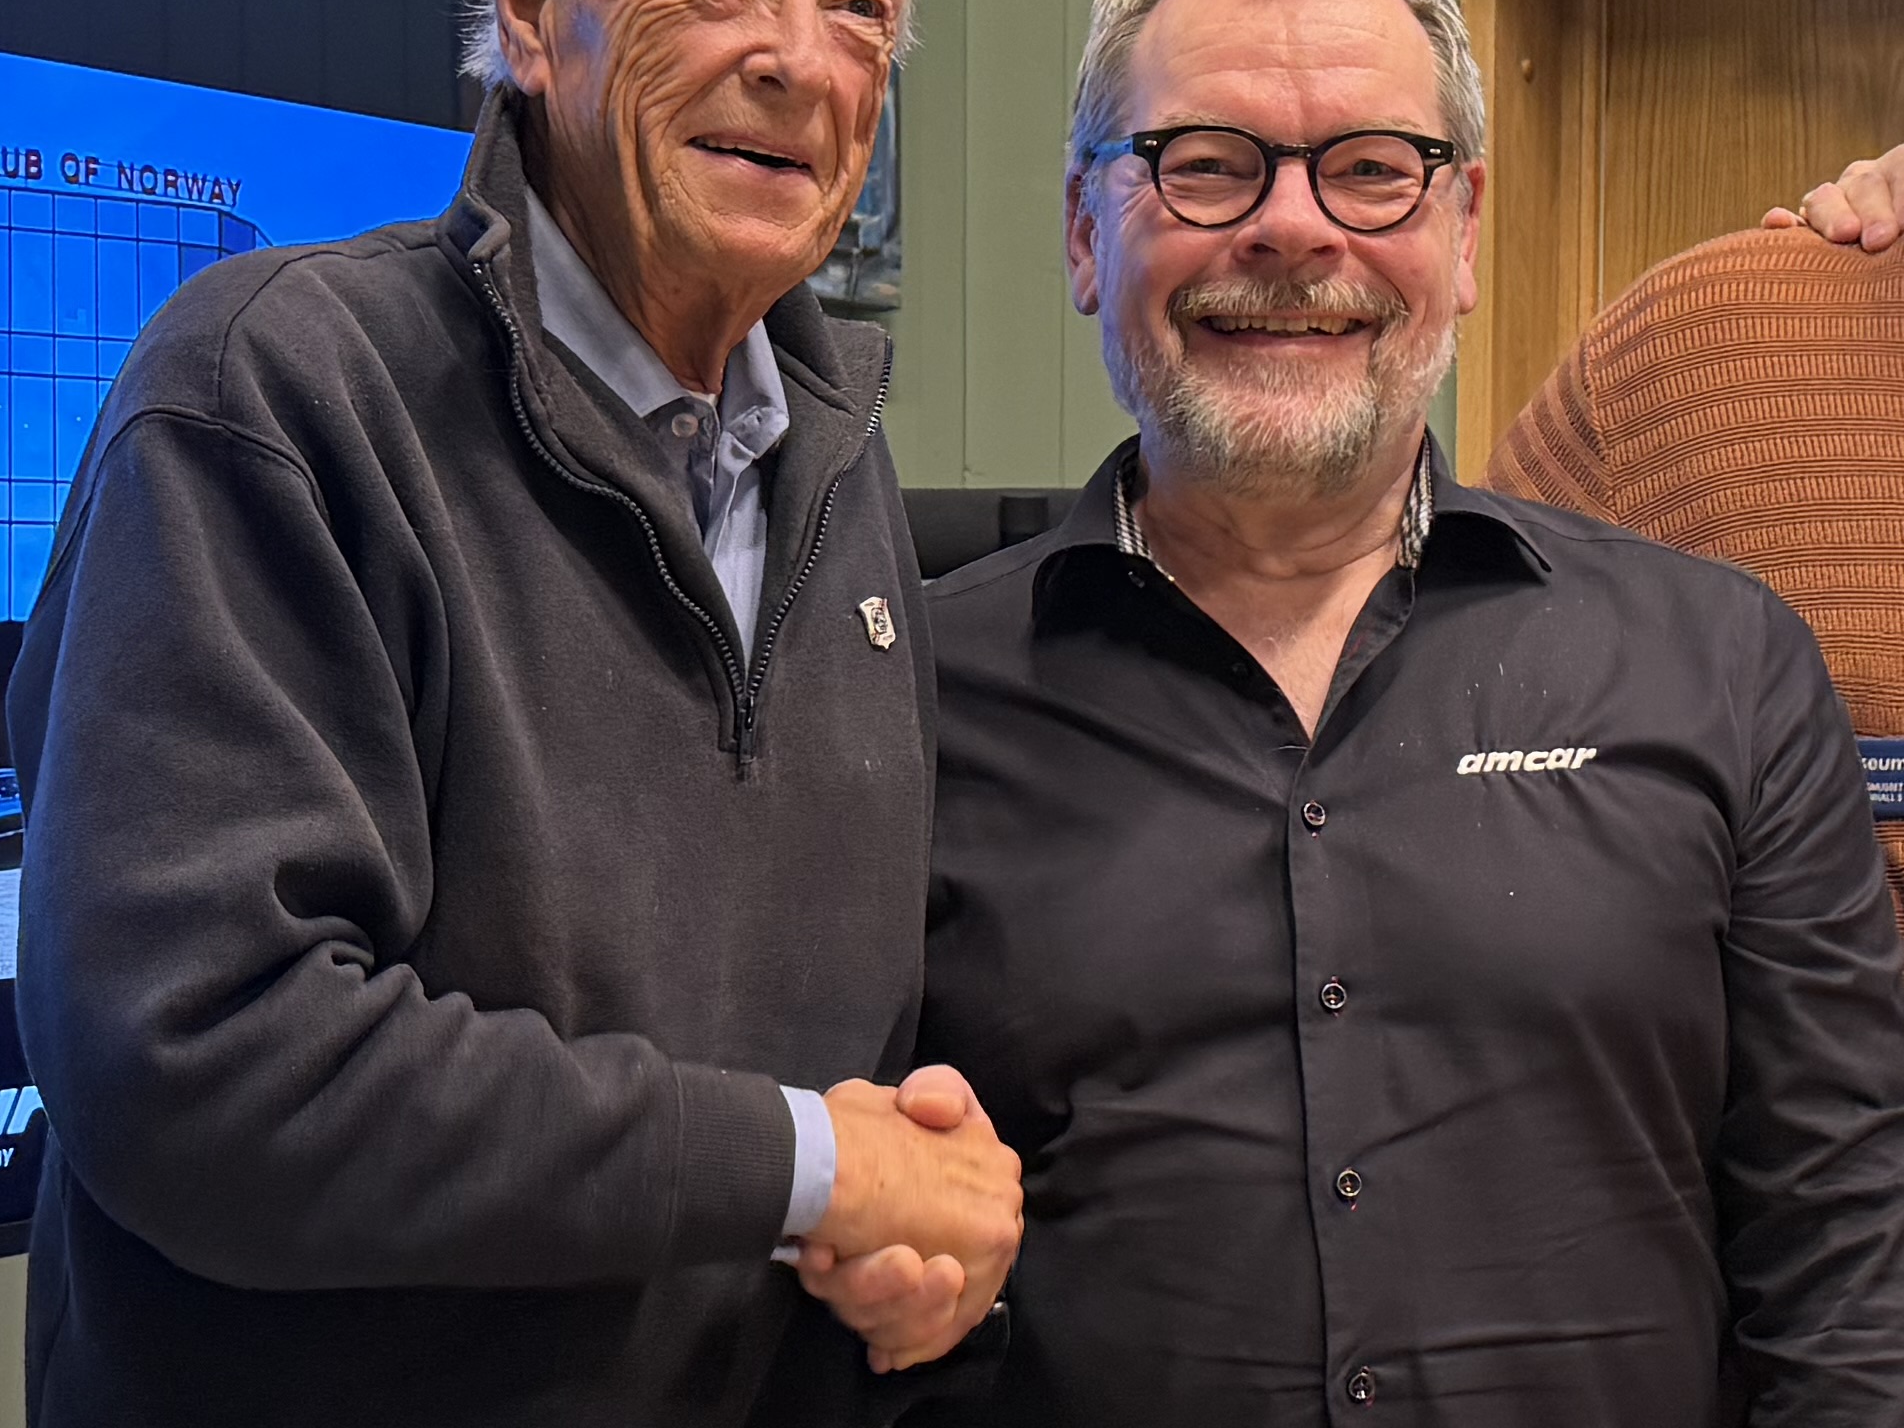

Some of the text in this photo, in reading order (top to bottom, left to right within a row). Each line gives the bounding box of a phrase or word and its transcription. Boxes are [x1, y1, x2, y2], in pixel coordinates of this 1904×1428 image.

[60, 152, 99, 184] OF
[117, 160, 242, 207] NORWAY
[1457, 747, 1597, 775] amcar
